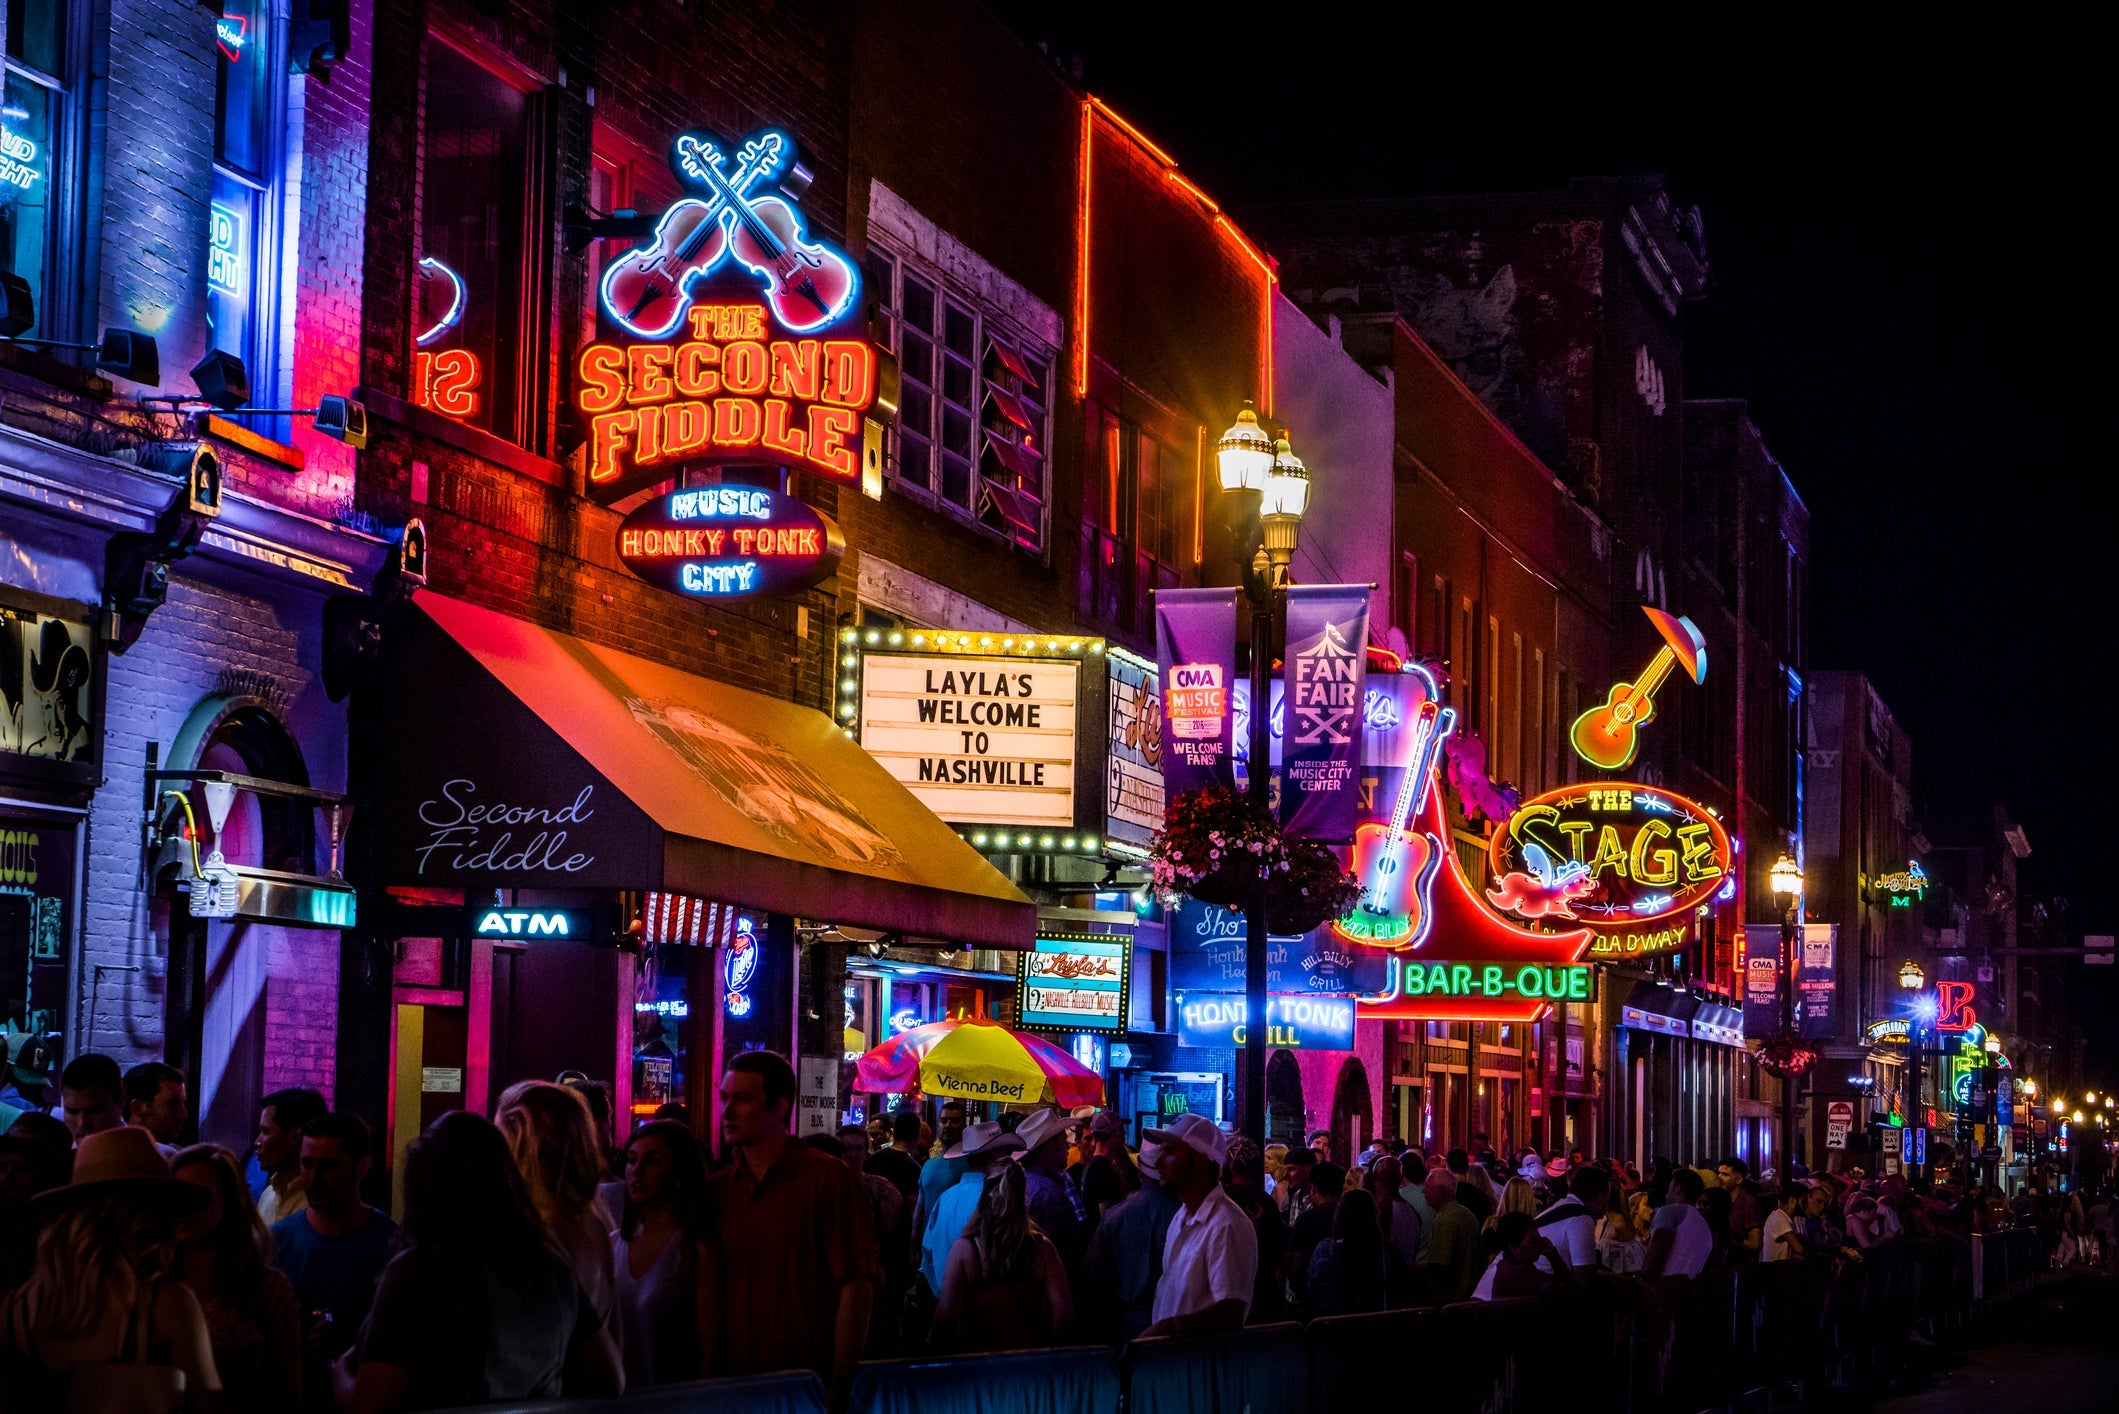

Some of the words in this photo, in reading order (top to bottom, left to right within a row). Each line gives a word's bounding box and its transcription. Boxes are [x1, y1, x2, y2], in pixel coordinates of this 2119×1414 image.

[688, 304, 768, 340] THE
[578, 340, 876, 412] SECOND
[590, 398, 859, 481] FIDDLE
[672, 489, 770, 521] MUSIC
[622, 528, 725, 556] HONKY
[733, 527, 820, 555] TONK
[682, 562, 757, 592] CITY
[1176, 670, 1214, 687] CMA
[1297, 658, 1357, 682] FAN
[925, 669, 1033, 698] LAYLA'S
[1295, 682, 1356, 706] FAIR
[1172, 691, 1220, 708] MUSIC
[1173, 707, 1220, 716] FESTIVAL
[917, 699, 1041, 728] WELCOME
[1294, 707, 1354, 744] X
[961, 730, 989, 755] TO
[1173, 743, 1223, 755] WELCOME
[918, 757, 1044, 787] NASHVILLE
[1186, 754, 1217, 766] FANS!
[1294, 760, 1329, 768] INSIDE
[1289, 768, 1326, 780] MUSIC
[1328, 767, 1352, 779] CITY
[1300, 780, 1342, 791] CENTER
[418, 779, 595, 828] Second
[1589, 789, 1632, 812] THE
[415, 826, 595, 875] Fiddle
[1509, 804, 1723, 888] STAGE
[477, 911, 569, 935] ATM
[1591, 926, 1687, 952] OADWAY
[1042, 951, 1117, 979] Layla's
[1301, 952, 1323, 972] HILL
[1323, 949, 1354, 970] BILLY
[1752, 960, 1773, 969] CMA
[1308, 975, 1345, 990] GRILL
[1404, 962, 1590, 1000] BAR-B-QUE
[1749, 970, 1776, 978] MUSIC
[1044, 991, 1070, 1009] NASHVILLE
[1097, 993, 1116, 1011] MUSIC
[1748, 992, 1776, 1000] WELCOME
[1185, 1001, 1275, 1027] HONY
[1279, 999, 1350, 1031] TONK
[1232, 1024, 1300, 1045] GILL
[815, 1076, 824, 1090] THE
[937, 1074, 988, 1095] Vienna
[990, 1080, 1025, 1101] Beef
[801, 1096, 819, 1109] ROBERT
[819, 1096, 836, 1110] MOORE
[1829, 1130, 1844, 1139] WAY
